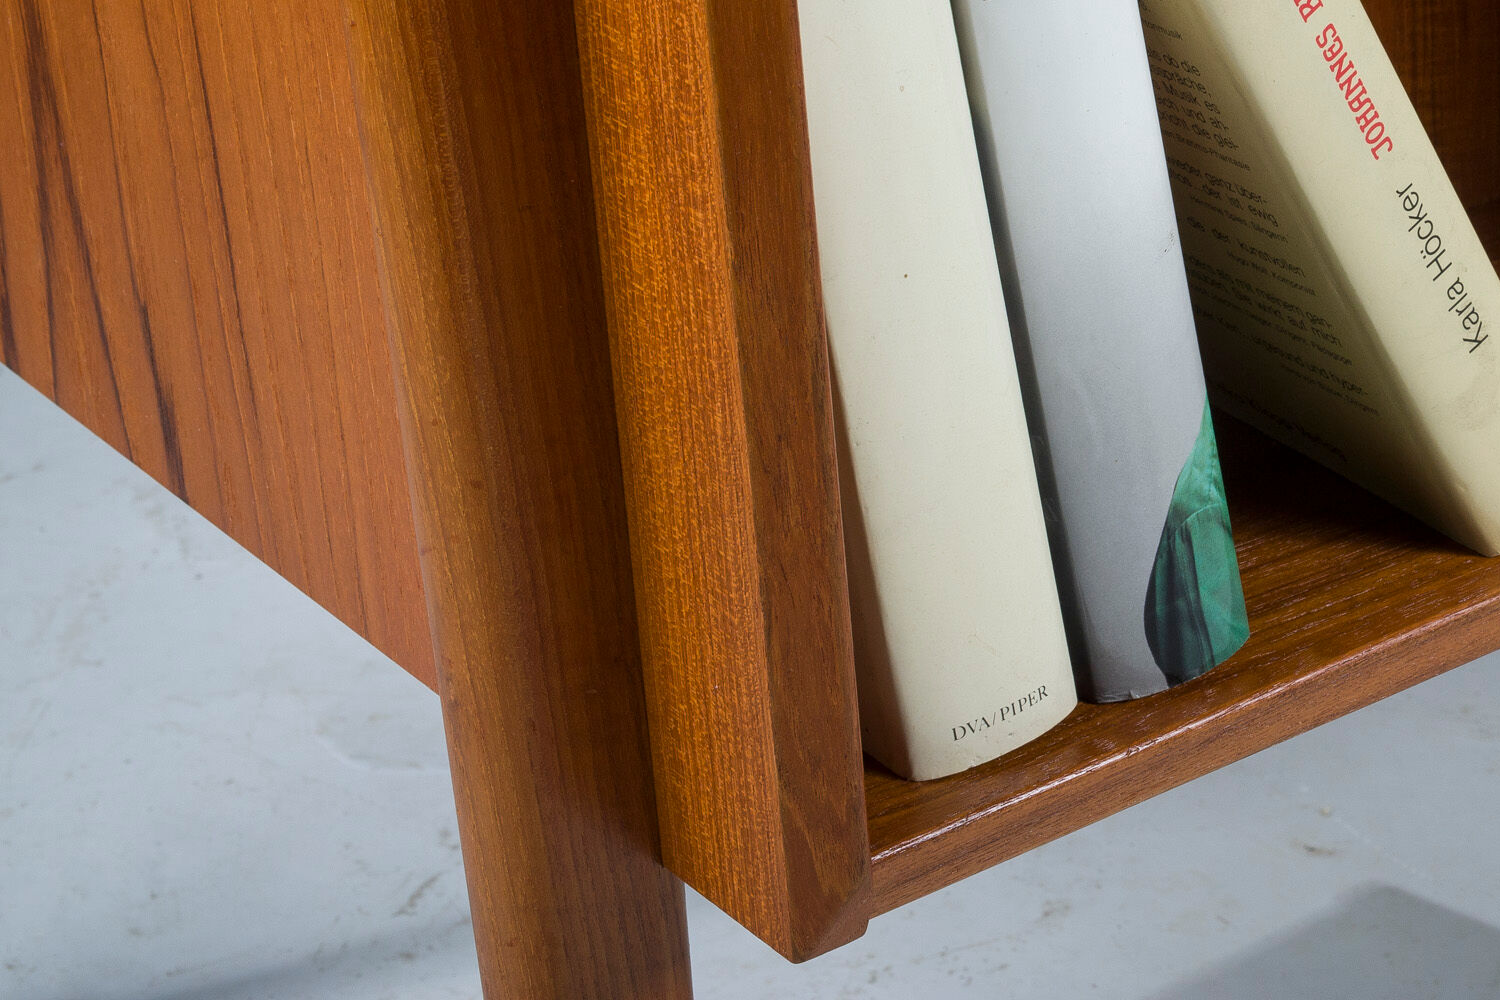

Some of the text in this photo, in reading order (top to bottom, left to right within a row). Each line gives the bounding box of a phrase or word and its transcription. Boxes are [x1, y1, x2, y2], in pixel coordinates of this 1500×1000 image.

[1315, 23, 1393, 160] JOHANNES
[1396, 183, 1489, 354] Karla Höcker
[951, 685, 1048, 741] DVA/PIPER
